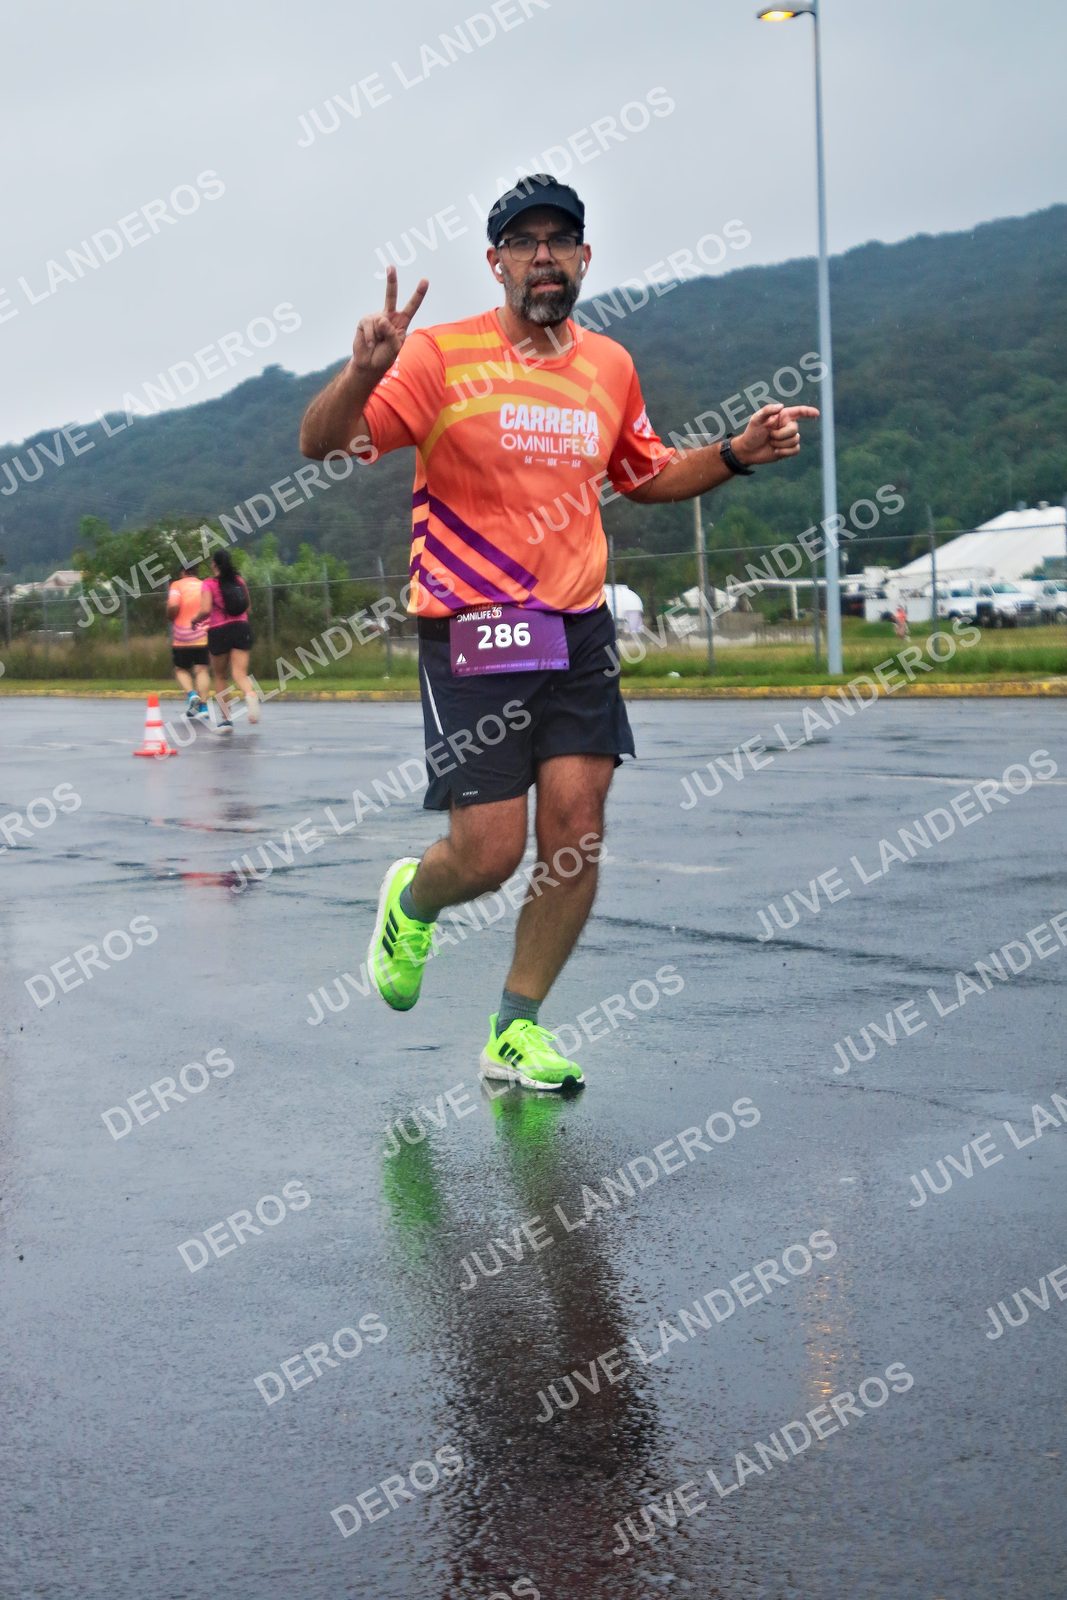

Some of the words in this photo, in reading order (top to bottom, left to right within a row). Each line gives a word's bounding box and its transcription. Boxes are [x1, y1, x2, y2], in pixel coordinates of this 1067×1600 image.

[500, 403, 599, 436] CARRERA
[501, 433, 580, 455] OMNILIFE
[457, 610, 491, 622] OMNILIFE
[477, 622, 531, 650] 286
